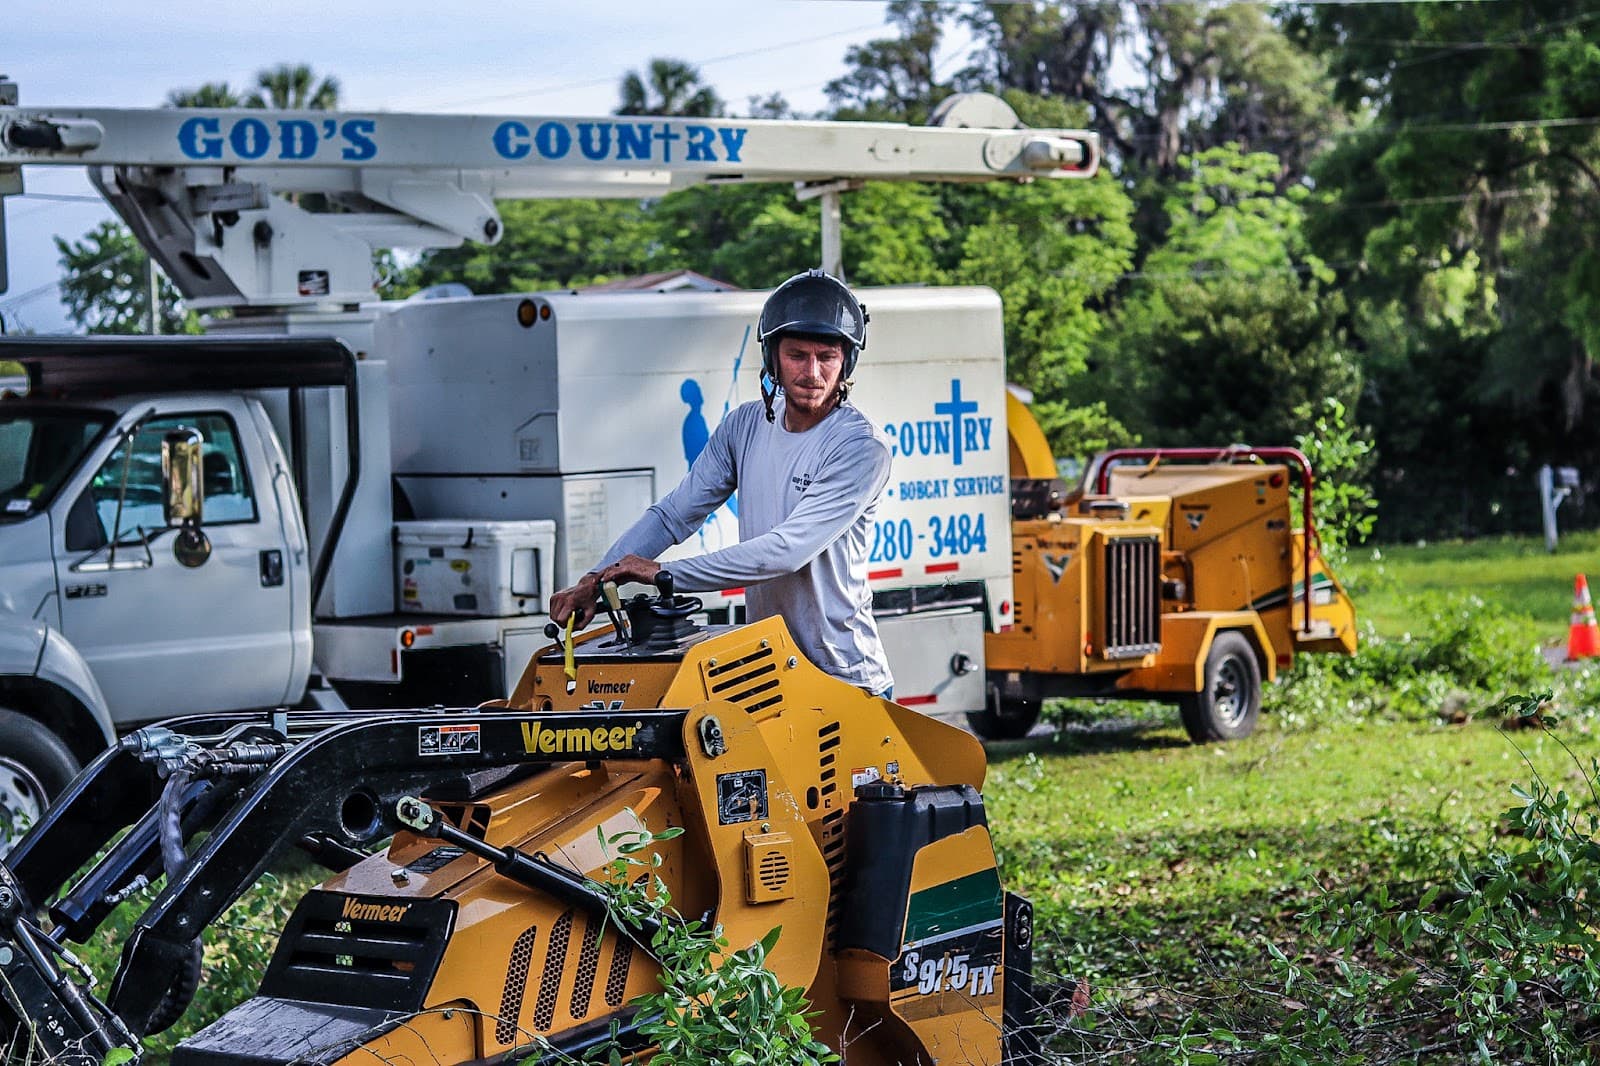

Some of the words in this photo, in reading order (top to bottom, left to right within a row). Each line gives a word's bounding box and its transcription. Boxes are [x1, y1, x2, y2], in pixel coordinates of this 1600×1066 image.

[177, 117, 378, 161] GOD'S
[492, 120, 748, 163] COUNTRY
[899, 479, 949, 501] BOBCAT
[953, 475, 1004, 497] SERVICE
[588, 679, 631, 694] Vermeer
[521, 721, 637, 754] Vermeer
[342, 897, 408, 922] Vermeer
